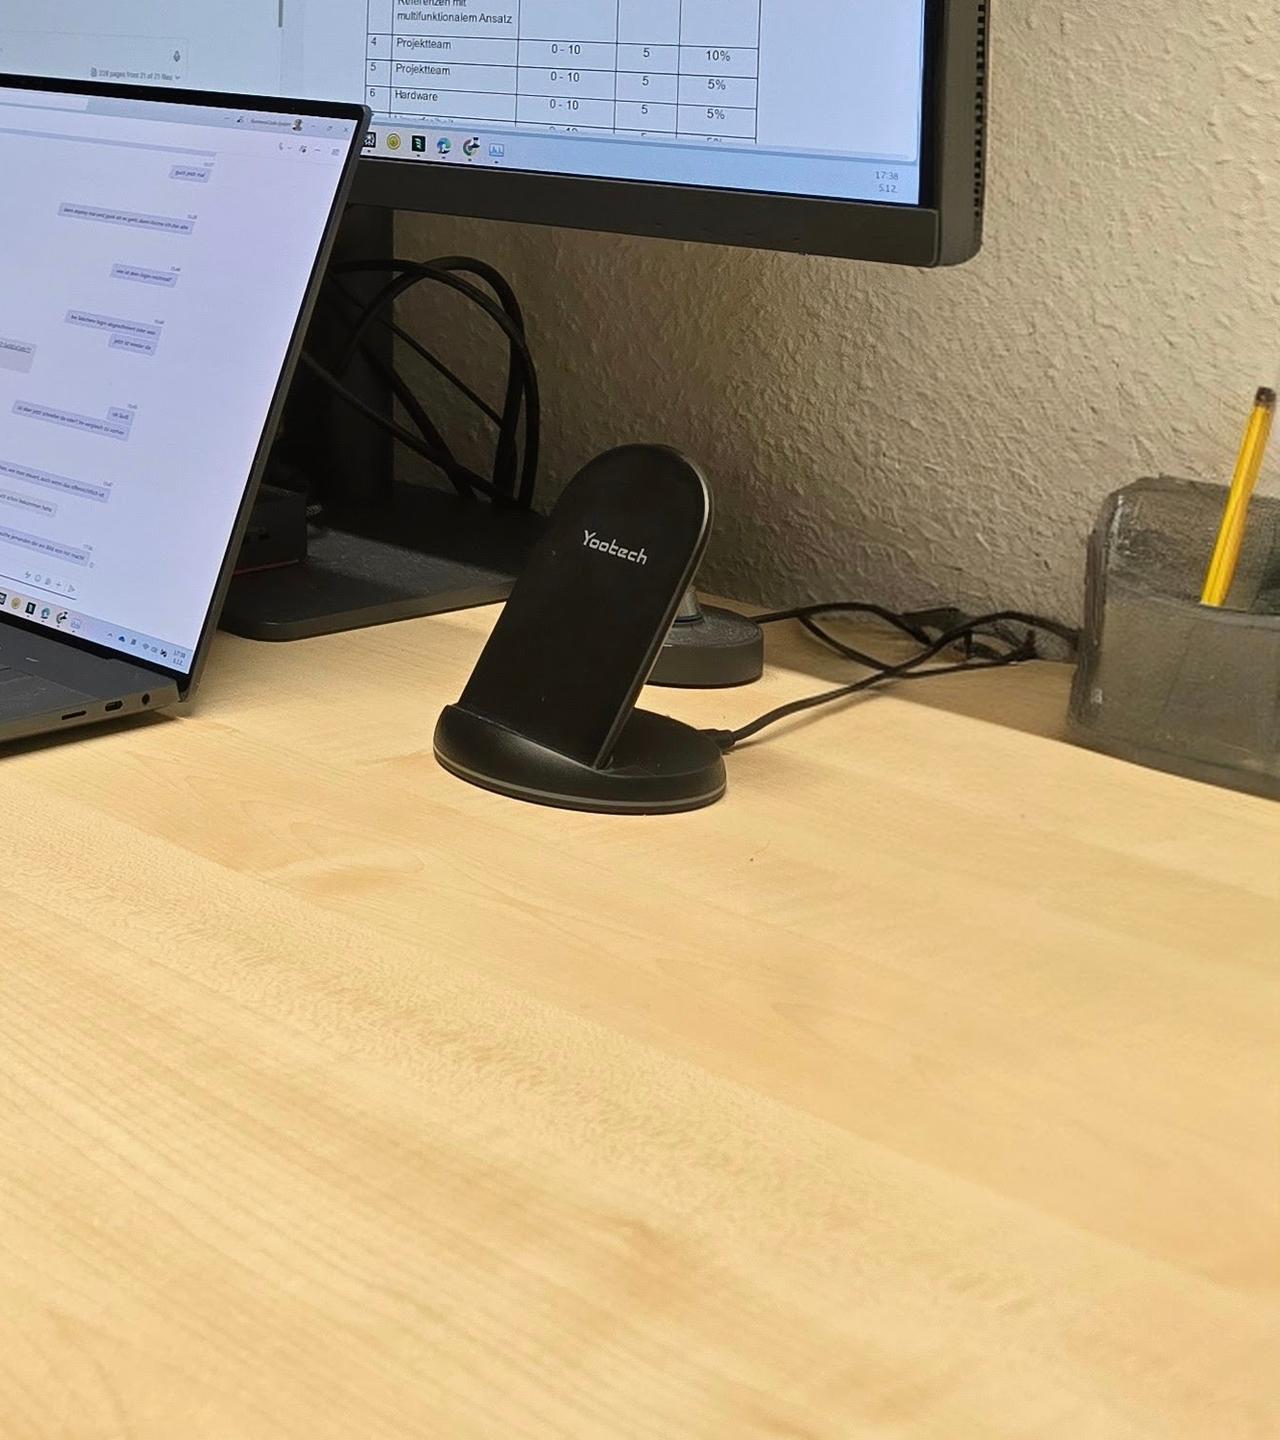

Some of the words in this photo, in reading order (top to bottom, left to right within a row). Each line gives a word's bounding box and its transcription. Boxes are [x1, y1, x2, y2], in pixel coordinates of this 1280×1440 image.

[396, 10, 477, 23] multifunktionalem
[478, 12, 512, 24] Ansatz
[396, 37, 451, 50] Projektteam
[395, 62, 450, 76] Projektteam
[394, 89, 438, 102] Hardware
[581, 529, 648, 565] Yootech
